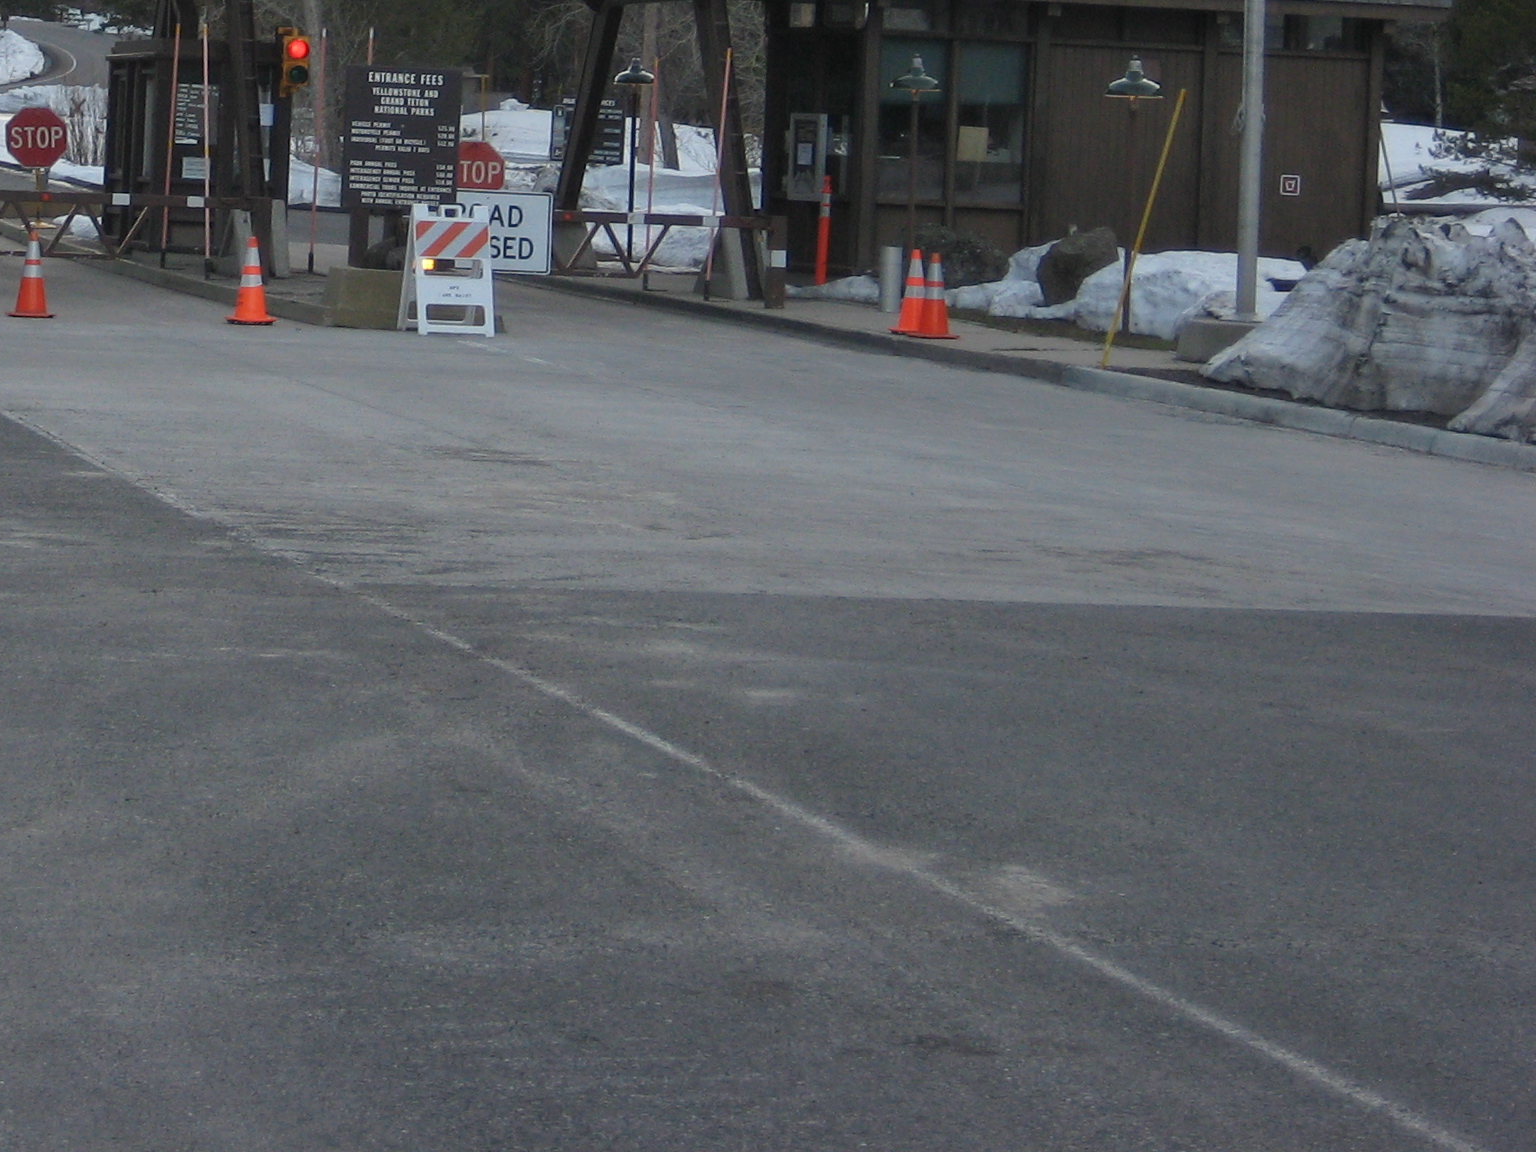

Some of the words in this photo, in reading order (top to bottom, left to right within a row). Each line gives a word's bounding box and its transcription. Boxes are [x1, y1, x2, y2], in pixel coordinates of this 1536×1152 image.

[368, 71, 416, 84] ENTRANCE
[420, 74, 444, 86] FEES
[372, 87, 421, 97] YELLOWSTONE
[424, 89, 439, 98] AND
[380, 97, 404, 106] GRAND
[408, 98, 430, 106] TETON
[374, 106, 408, 115] NATIONAL
[410, 108, 434, 116] PARKS
[10, 126, 63, 148] STOP
[460, 160, 502, 184] TOP
[490, 236, 534, 260] SED
